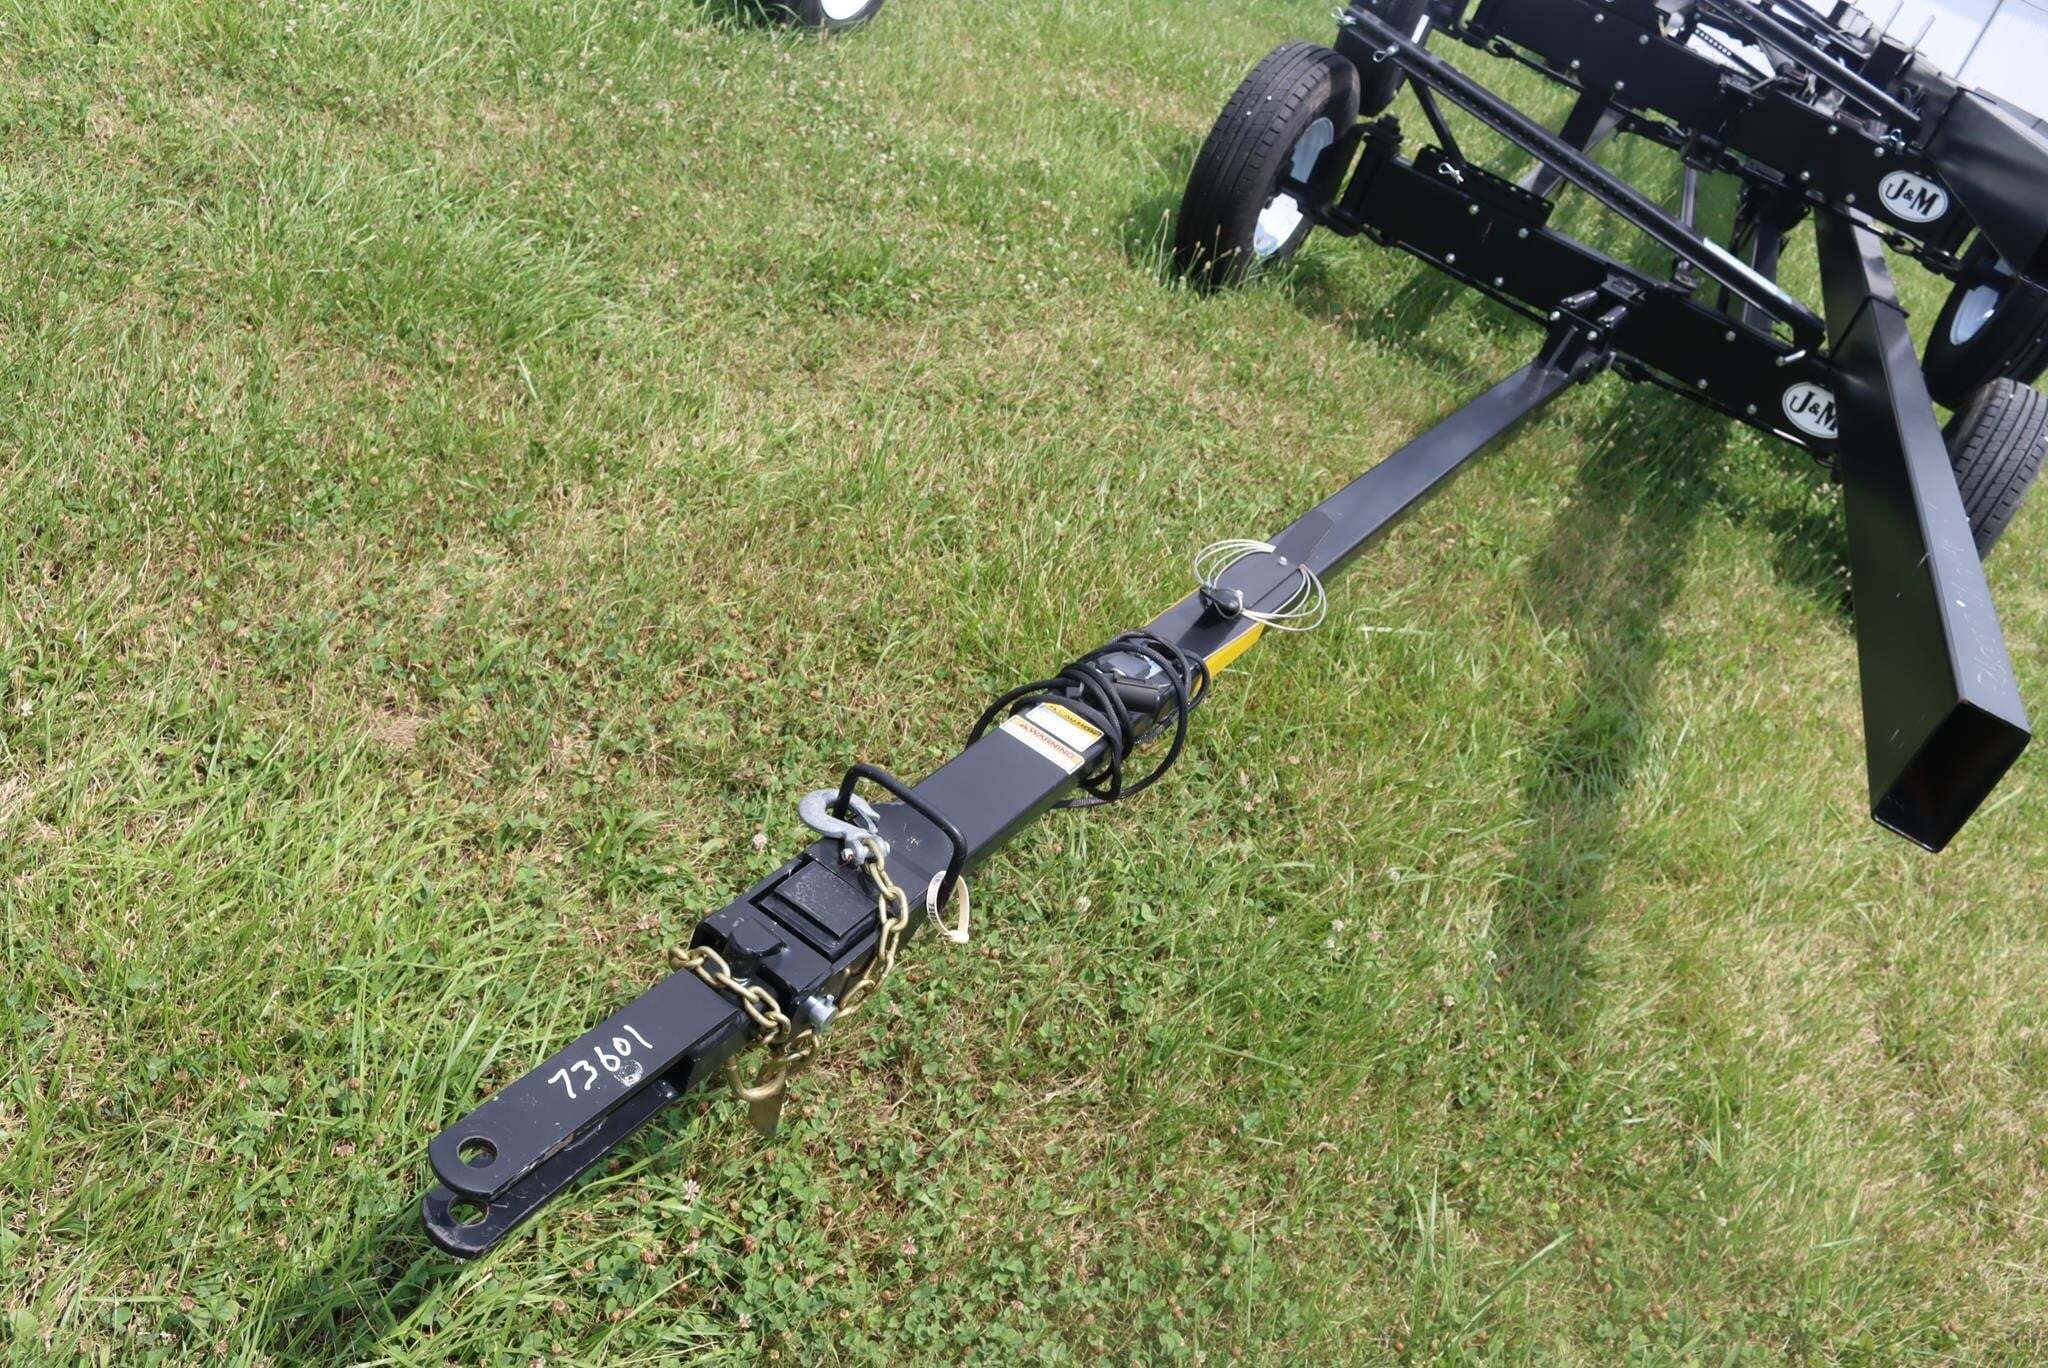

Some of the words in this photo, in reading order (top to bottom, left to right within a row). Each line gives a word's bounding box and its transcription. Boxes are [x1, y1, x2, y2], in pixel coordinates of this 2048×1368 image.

[1885, 178, 1940, 217] J&M
[1028, 726, 1074, 759] WARNING
[547, 1024, 653, 1099] 73601
